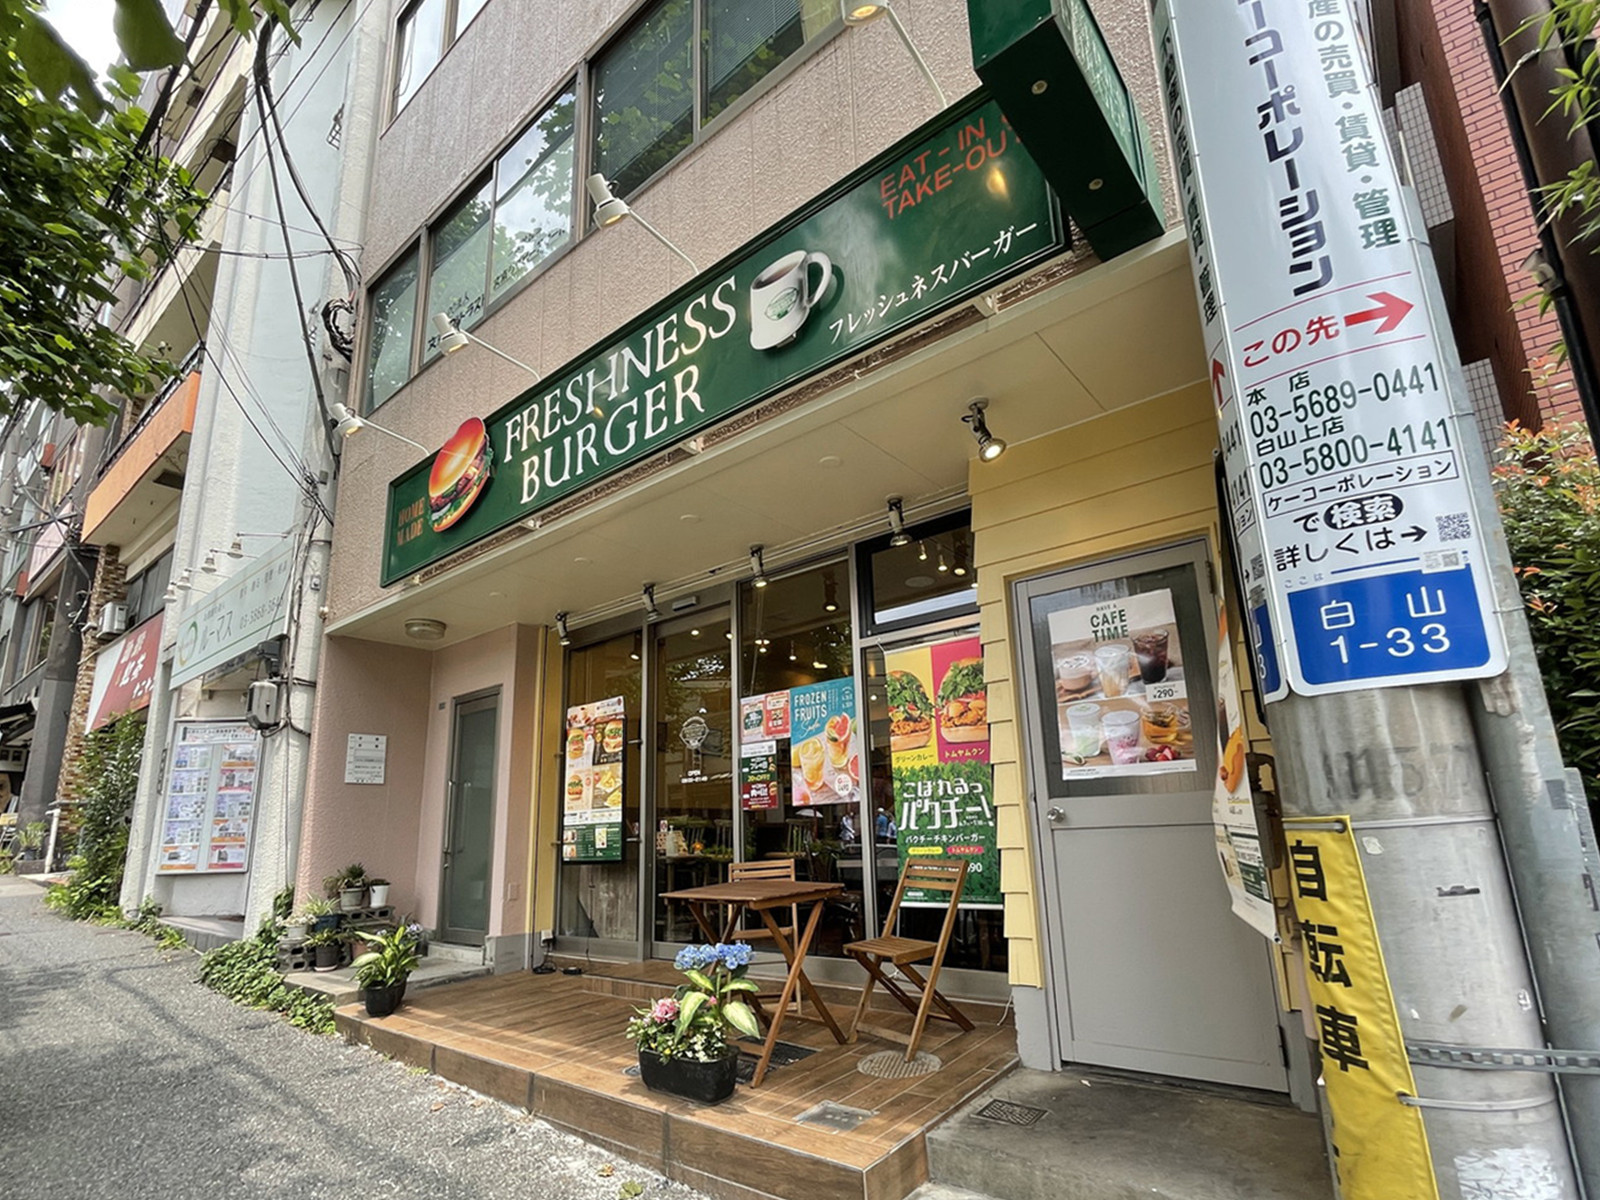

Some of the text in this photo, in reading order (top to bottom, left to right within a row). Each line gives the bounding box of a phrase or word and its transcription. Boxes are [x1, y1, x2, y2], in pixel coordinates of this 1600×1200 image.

[882, 127, 1021, 219] TAKE-OU
[1238, 0, 1333, 296] ーコーポレーション
[828, 222, 1037, 344] フレッシュネスバーガー
[1243, 316, 1340, 367] この先
[504, 275, 736, 463] FRESHNESS
[1250, 362, 1438, 438] 03-5689-0441
[520, 365, 705, 504] BURGER
[1256, 416, 1345, 457] 白山上店
[1259, 418, 1452, 489] 03-5800-4141
[1267, 460, 1452, 512] ケーコーポレーション
[1273, 527, 1396, 572] 詳しくは
[1090, 609, 1127, 628] CAFE
[1092, 624, 1129, 643] TIME
[1330, 622, 1451, 664] 1-33
[794, 691, 828, 707] FROZEN
[794, 705, 828, 722] FRUITS
[945, 748, 985, 758] トムヤムクン
[903, 777, 983, 798] こぼれるっ
[1289, 839, 1370, 1072] 自転車
